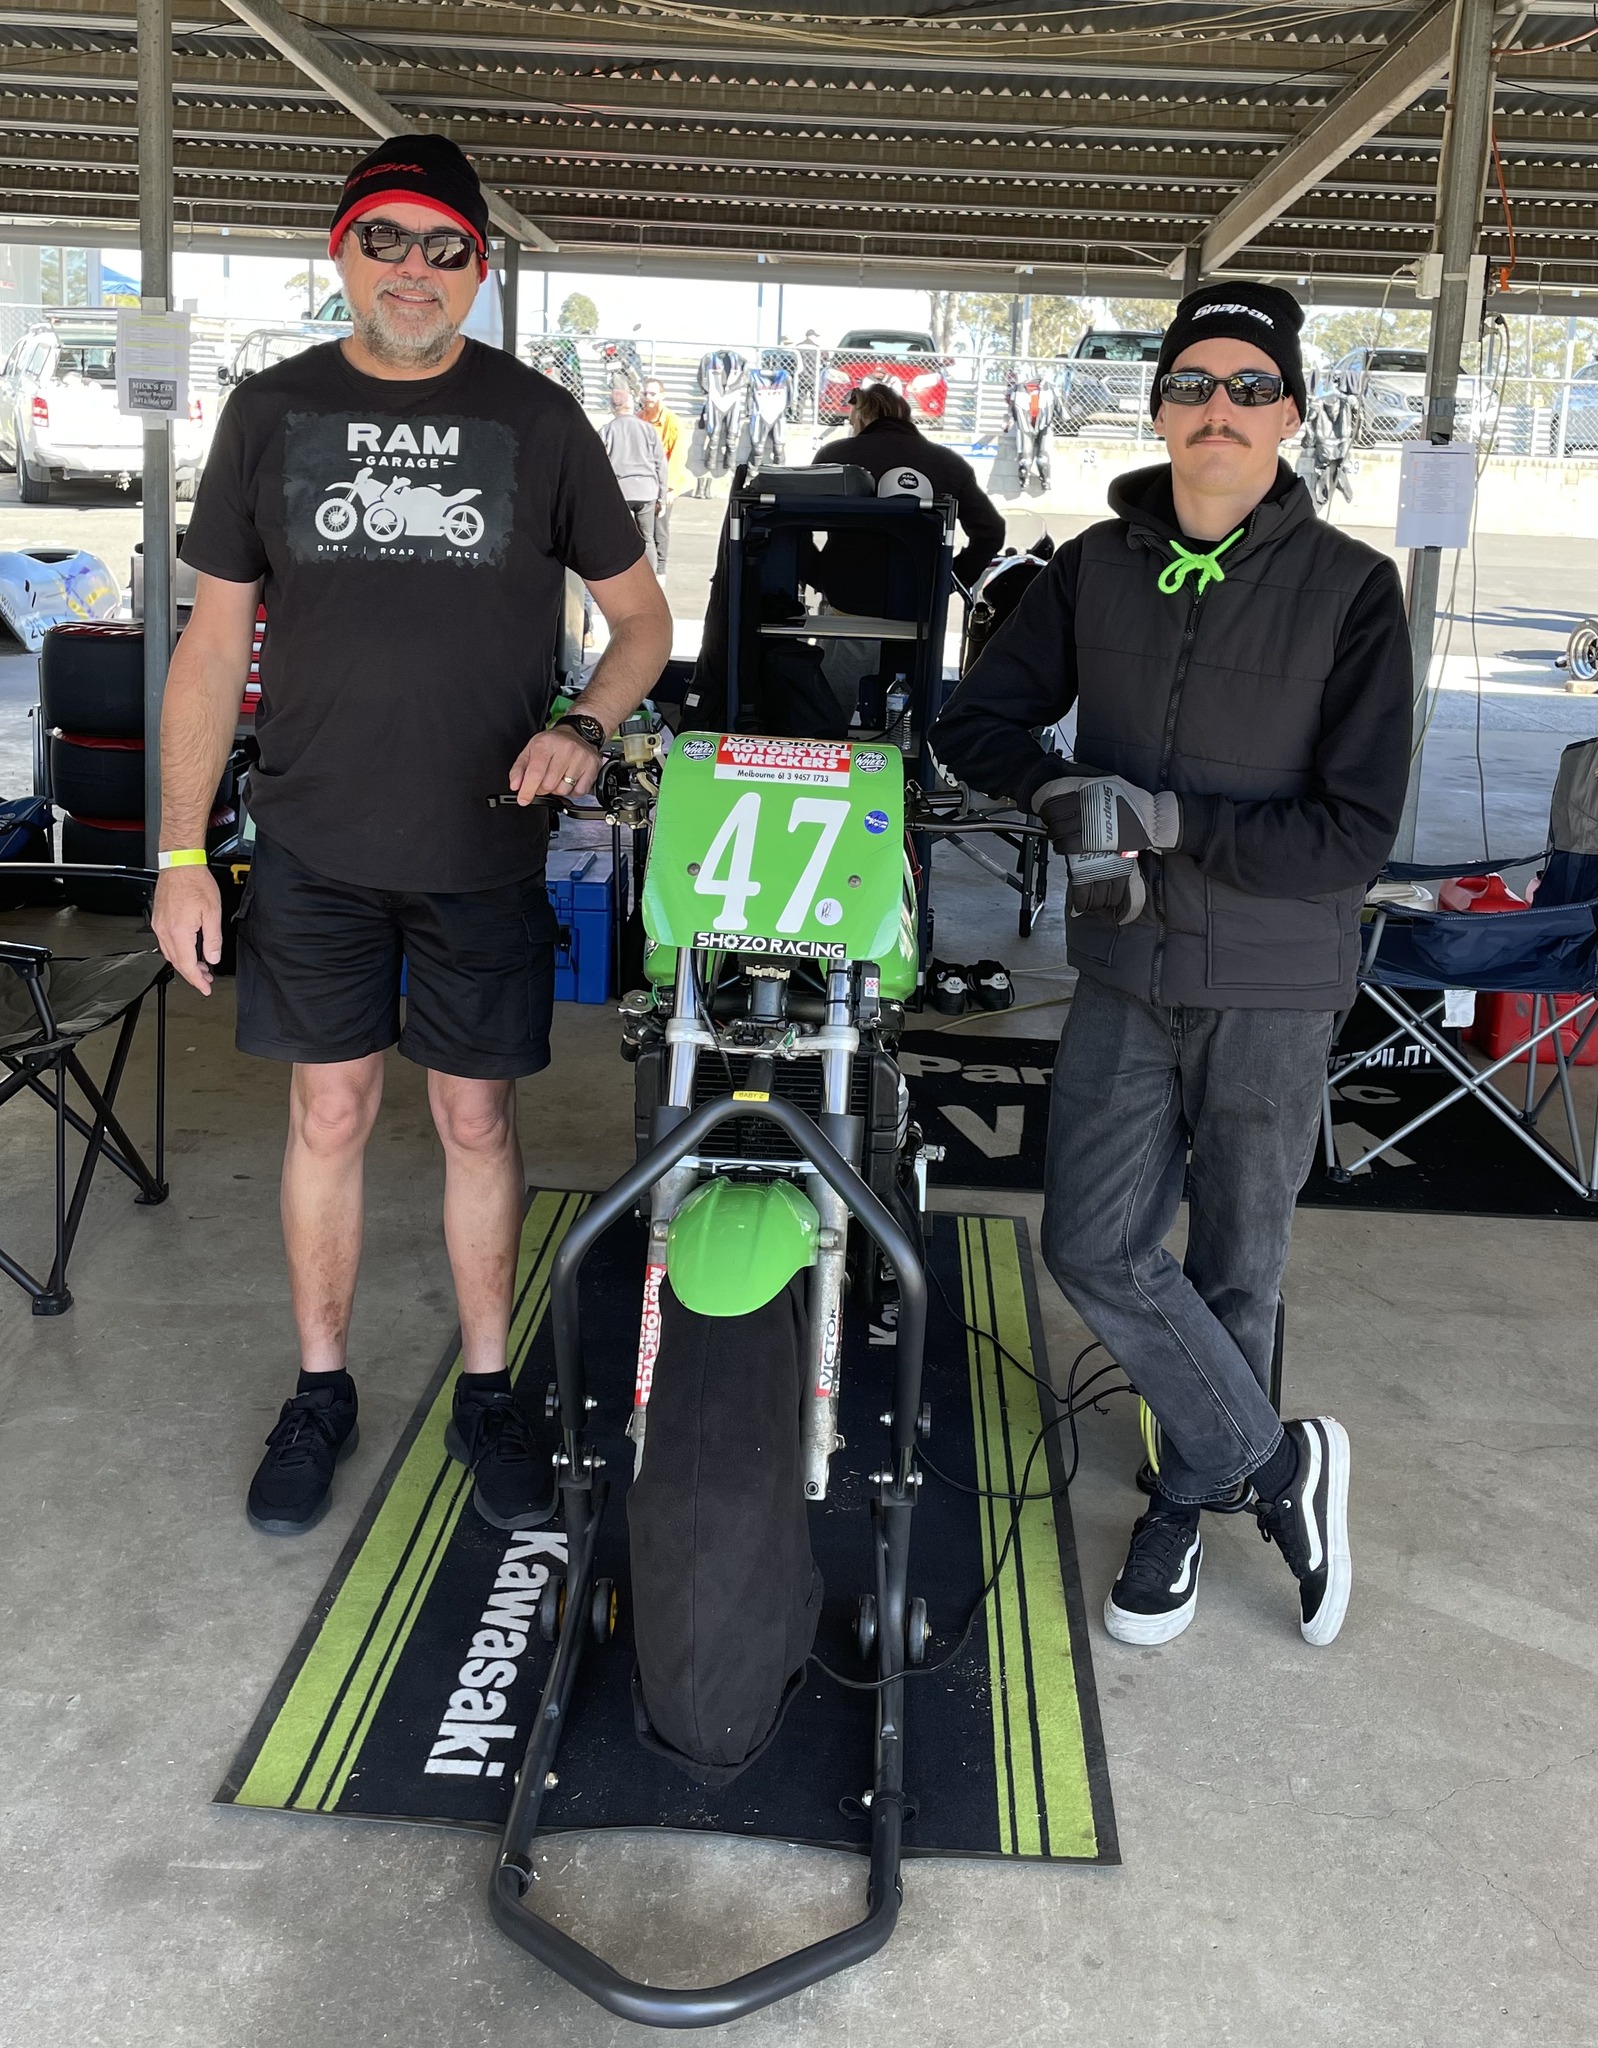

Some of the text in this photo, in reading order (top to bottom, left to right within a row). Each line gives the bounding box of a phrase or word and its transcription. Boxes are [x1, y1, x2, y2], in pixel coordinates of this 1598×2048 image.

[347, 422, 460, 456] RAM
[365, 455, 440, 469] GARAGE
[317, 544, 479, 560] DIRT ROAD RACE
[720, 742, 851, 759] MOTORCYCLE
[730, 737, 845, 750] VICTORIAN
[732, 752, 838, 770] WRECKERS
[737, 769, 775, 779] Melbourne
[794, 773, 811, 781] 9457
[813, 774, 829, 783] 1733
[694, 791, 851, 934] 47
[696, 932, 845, 959] SHOZO RACING
[640, 1266, 663, 1404] MOTORCYCLE
[424, 1530, 569, 1777] Kawasaki
